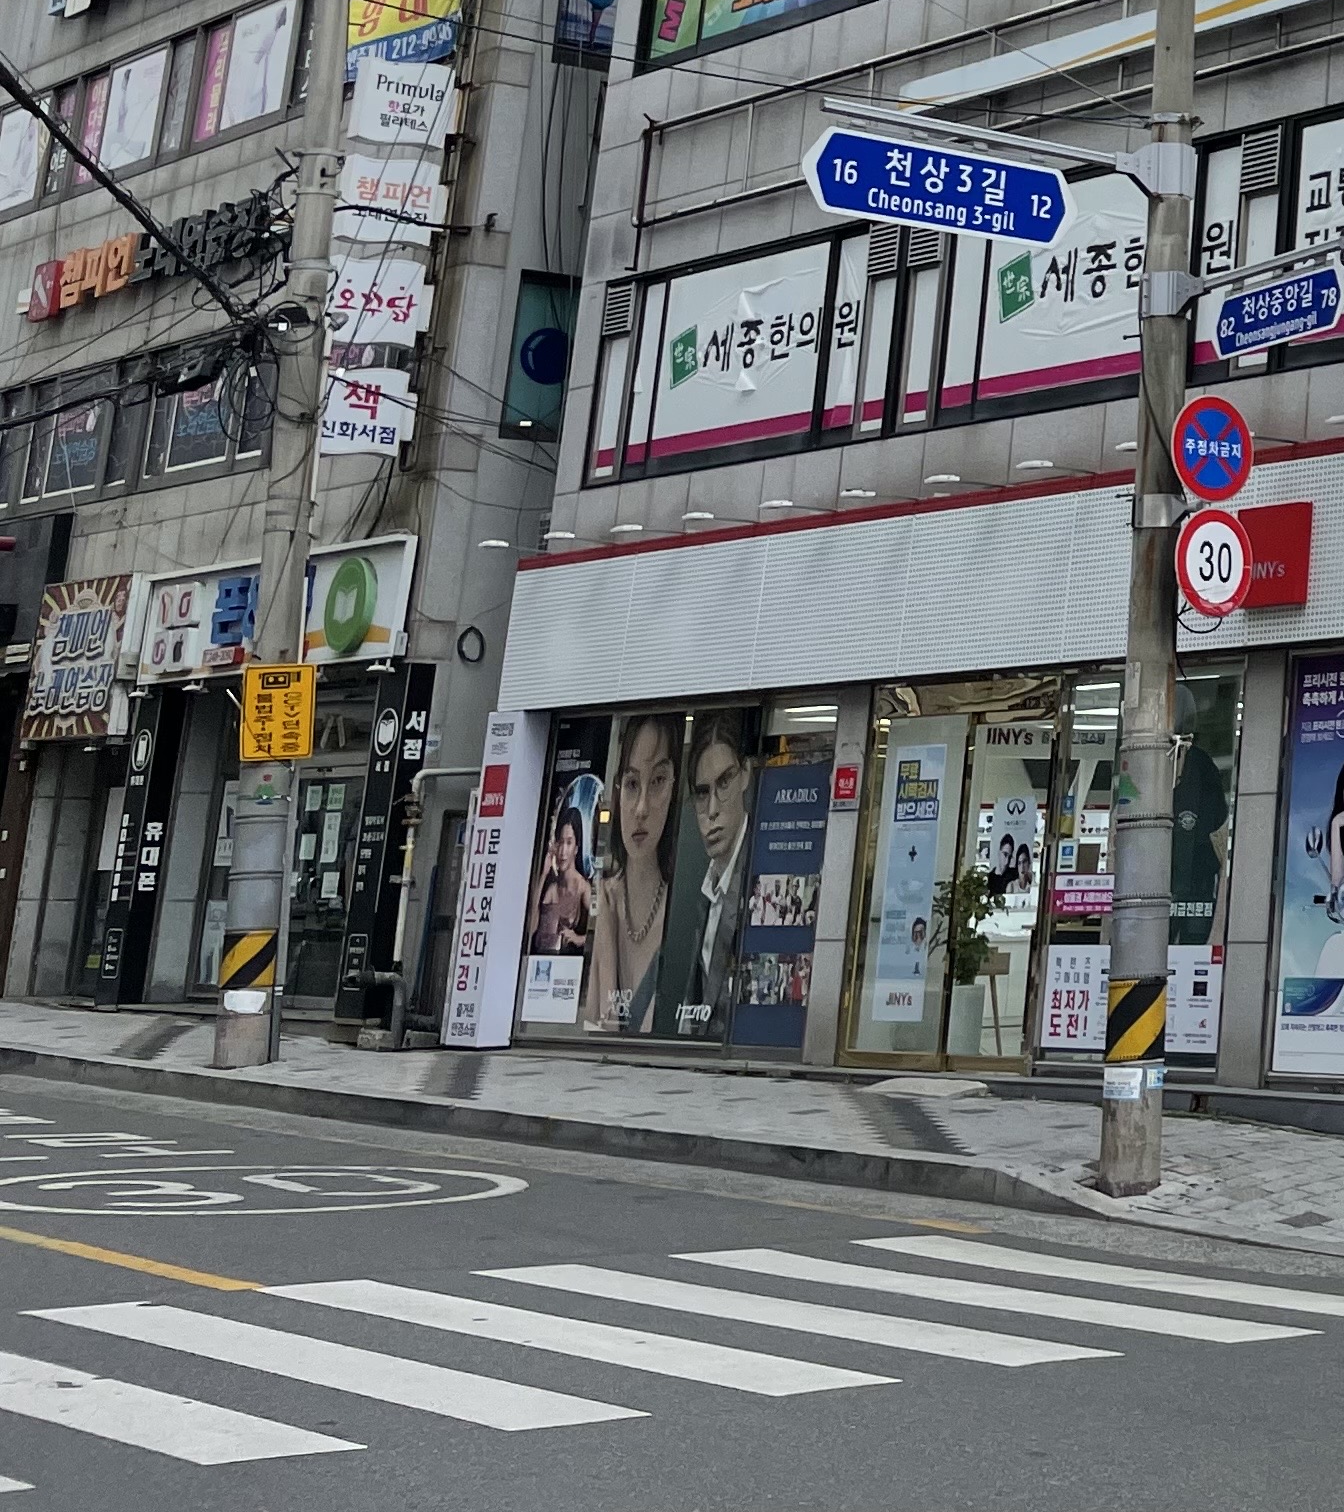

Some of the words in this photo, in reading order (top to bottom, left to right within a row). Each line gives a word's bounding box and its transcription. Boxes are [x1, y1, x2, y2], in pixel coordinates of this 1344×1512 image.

[377, 73, 444, 101] Primula
[388, 100, 425, 117] 핫요가
[356, 176, 433, 209] 챔피언
[833, 158, 858, 186] 16
[883, 148, 1009, 208] 천상3길
[1029, 194, 1052, 221] 12
[866, 187, 966, 227] Cheonsang
[972, 205, 1015, 232] 3-gil
[60, 232, 138, 309] 챔피언
[1220, 317, 1235, 338] 82
[1242, 279, 1313, 324] 천상중앙길
[1321, 287, 1337, 309] 78
[702, 299, 861, 372] 세종한의원
[344, 380, 382, 421] 책
[321, 419, 396, 446] 신화서점
[1185, 438, 1242, 459] 주정차금지
[1199, 540, 1233, 584] 30
[1251, 563, 1285, 579] INY's
[1303, 672, 1337, 687] 프리시전
[1302, 690, 1337, 706] 촉촉하게
[403, 710, 426, 761] 서점
[774, 788, 819, 804] ARKADIUS
[137, 822, 163, 891] 휴대폰
[456, 828, 487, 992] 지니스안경
[1051, 988, 1090, 1011] 최저가
[1049, 1014, 1088, 1039] 도전!
[38, 1173, 442, 1208] 30
